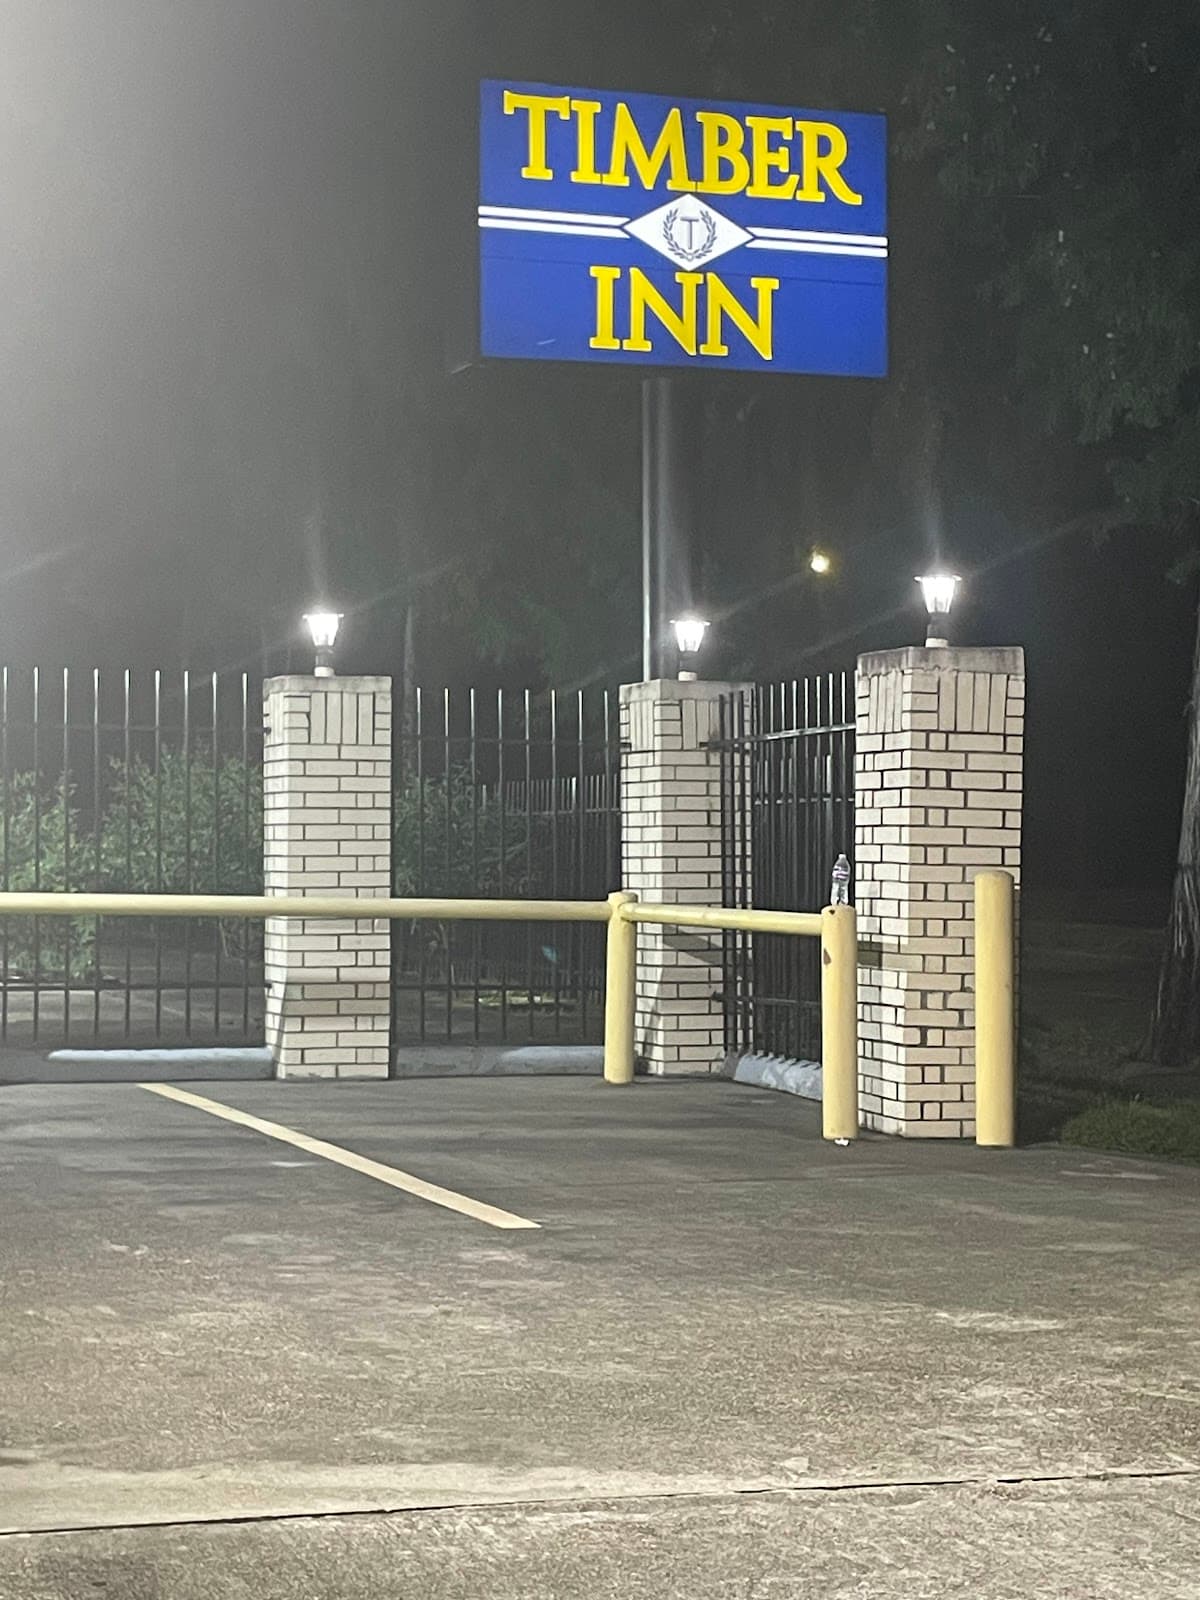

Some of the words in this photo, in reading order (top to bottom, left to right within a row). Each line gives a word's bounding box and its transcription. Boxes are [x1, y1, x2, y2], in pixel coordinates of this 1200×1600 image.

[503, 90, 862, 205] TIMBER
[680, 216, 700, 250] T
[589, 265, 779, 360] INN
